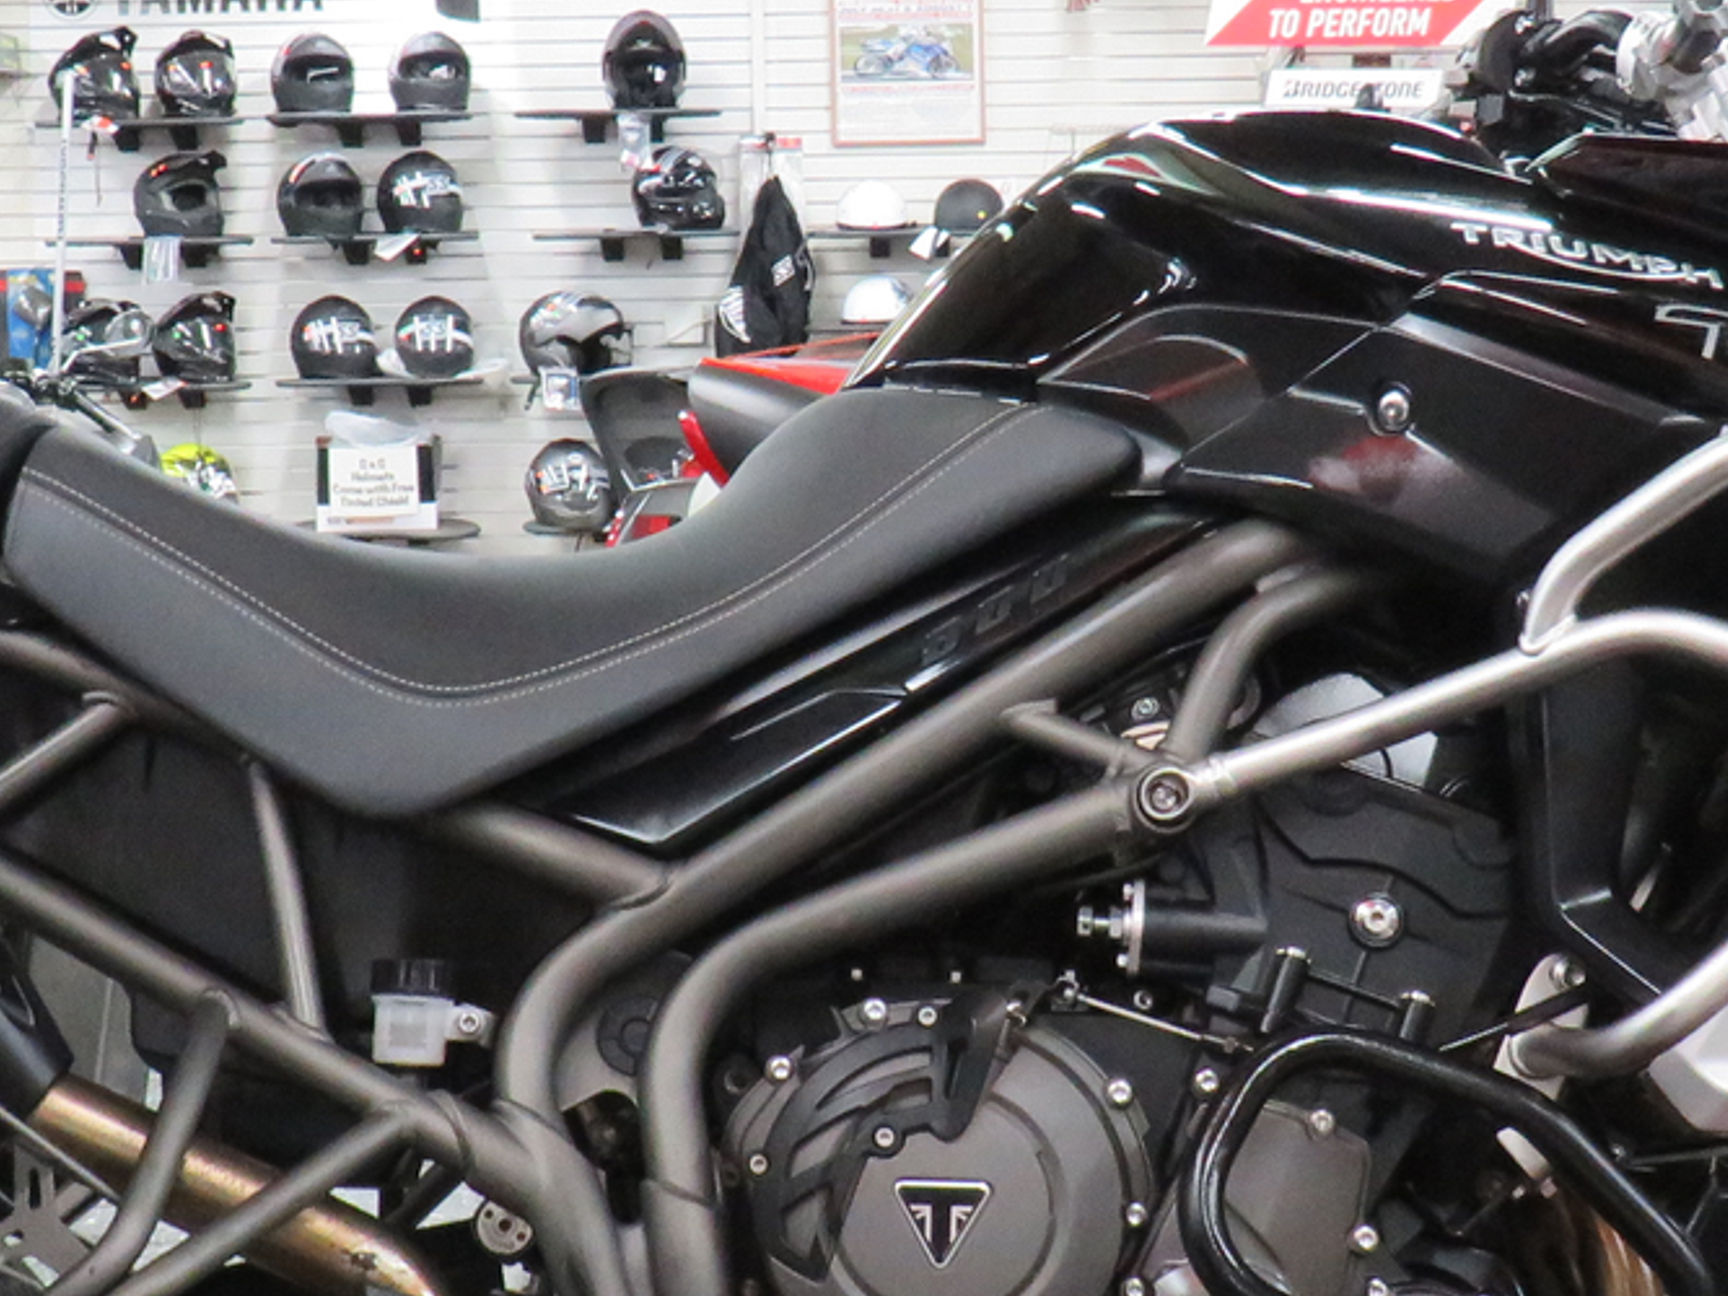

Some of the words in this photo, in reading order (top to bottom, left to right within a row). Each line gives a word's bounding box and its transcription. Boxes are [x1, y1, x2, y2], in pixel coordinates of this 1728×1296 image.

[1268, 8, 1303, 39] TO
[1305, 6, 1433, 38] PERFORM
[1451, 220, 1725, 290] TRIUMPH
